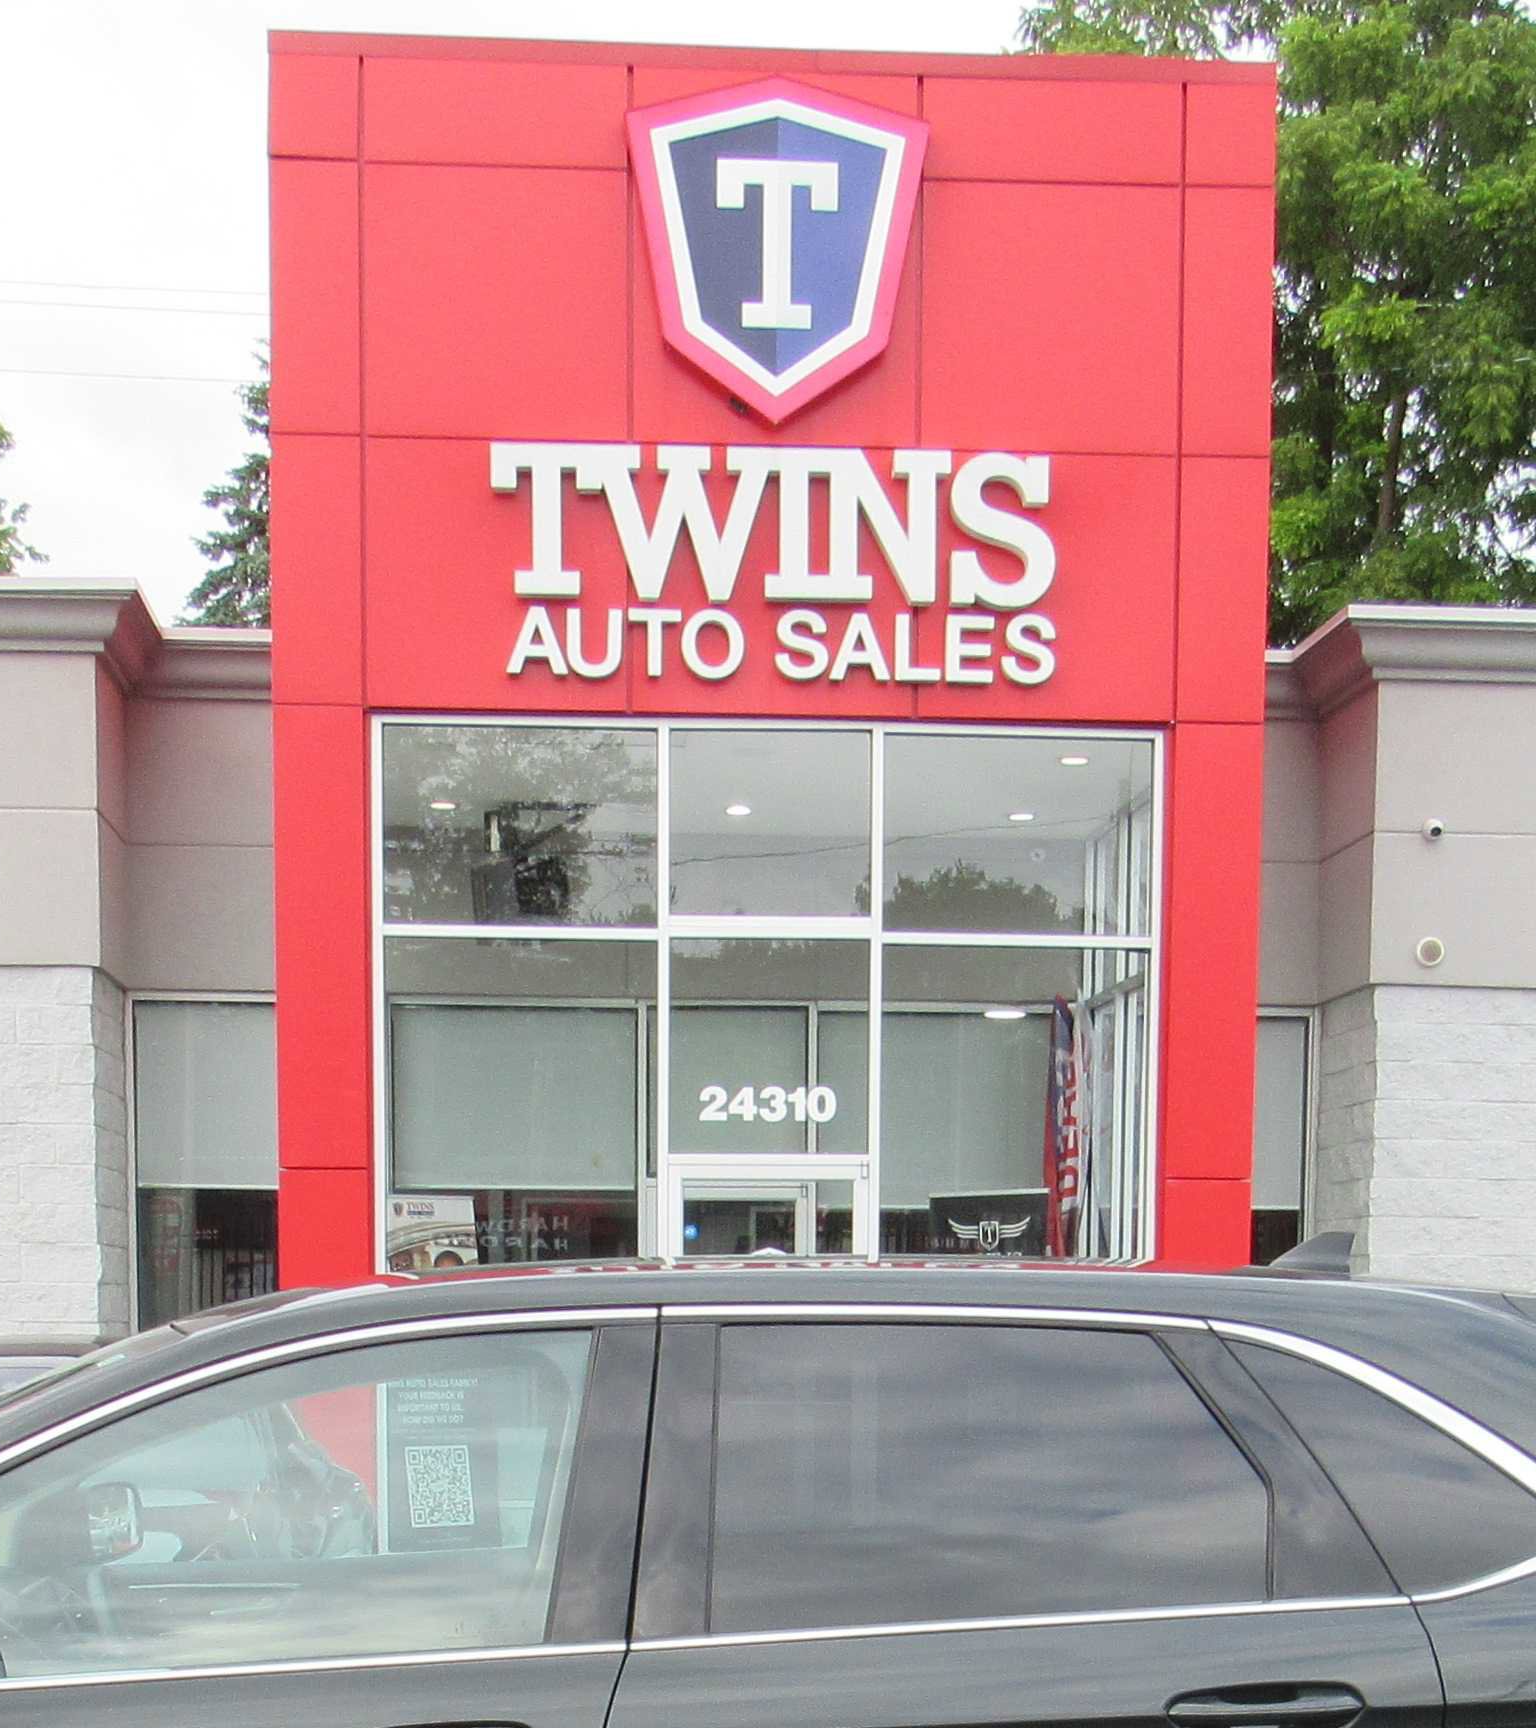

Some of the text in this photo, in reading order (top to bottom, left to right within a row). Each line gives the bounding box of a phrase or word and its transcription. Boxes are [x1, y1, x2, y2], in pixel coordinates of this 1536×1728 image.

[716, 159, 839, 330] T
[489, 443, 1057, 612] TWINS
[506, 606, 1057, 685] AUTO SALES
[698, 1085, 838, 1123] 24310
